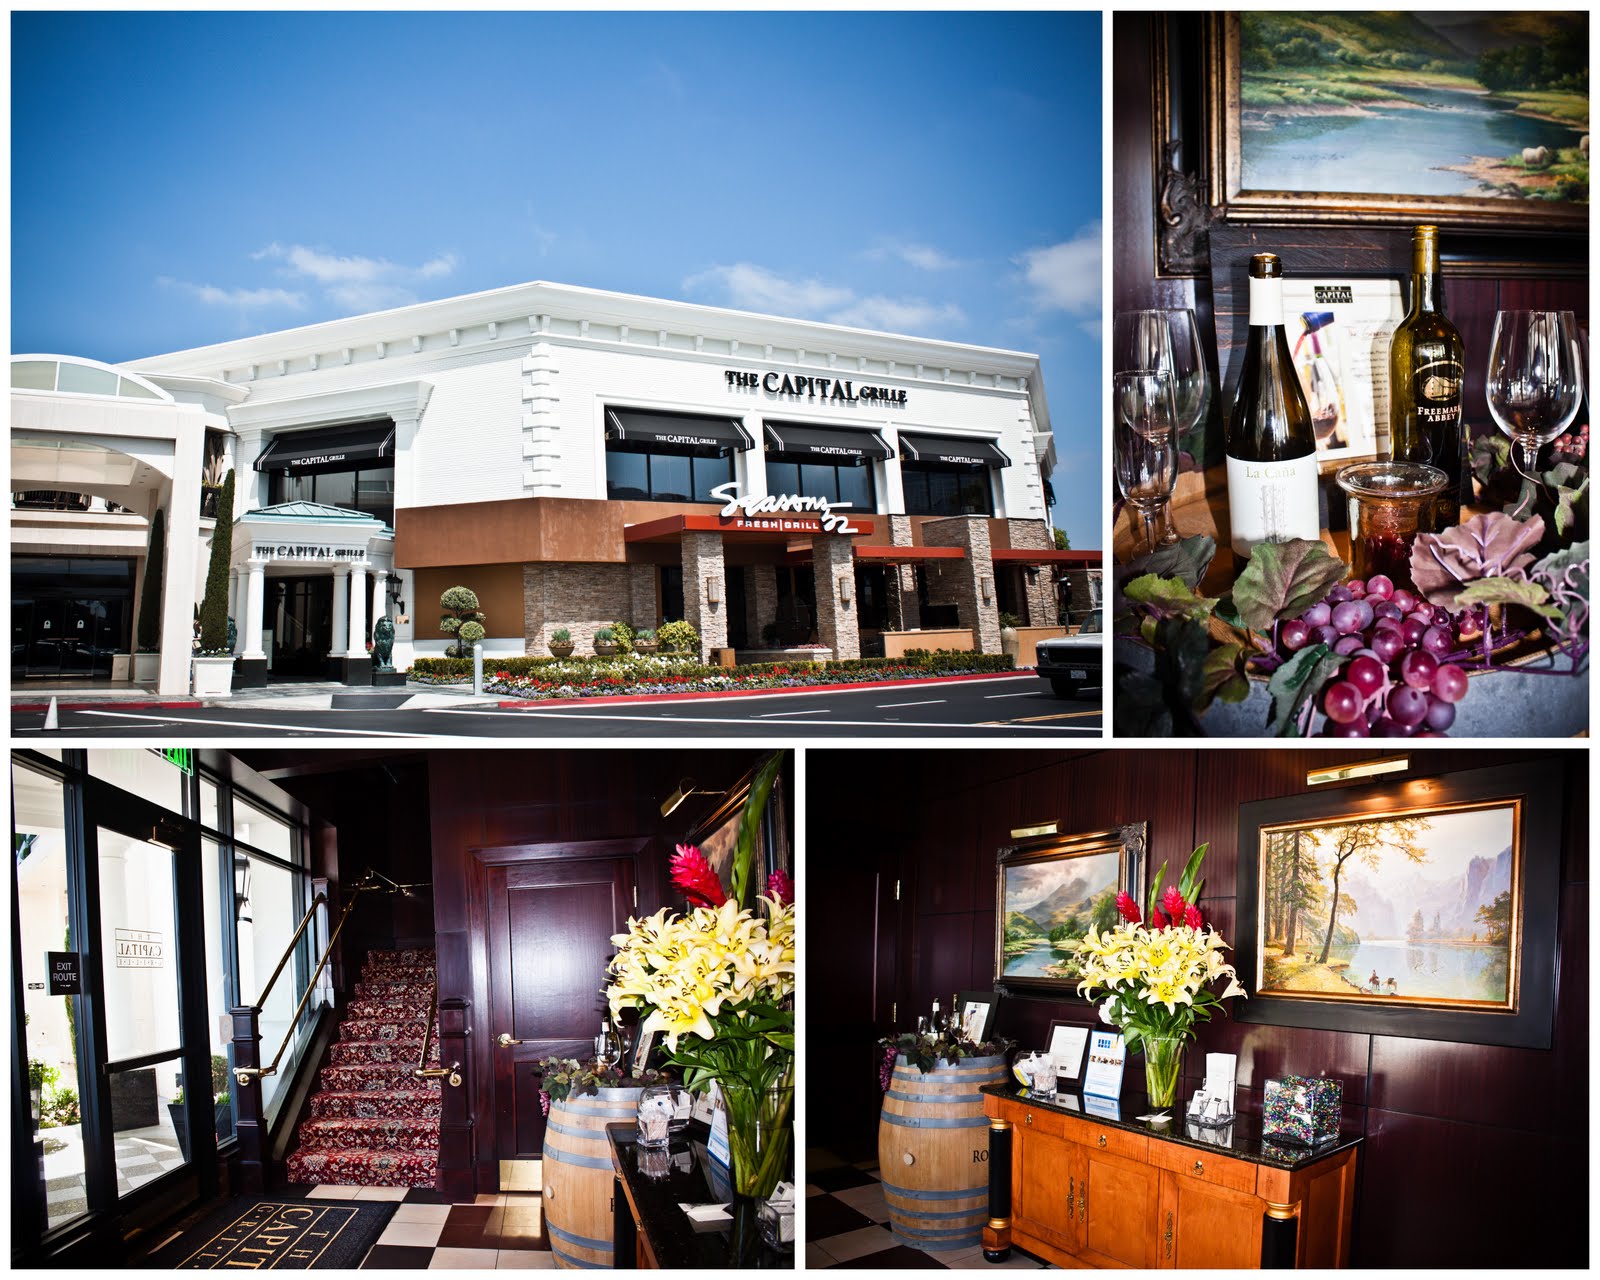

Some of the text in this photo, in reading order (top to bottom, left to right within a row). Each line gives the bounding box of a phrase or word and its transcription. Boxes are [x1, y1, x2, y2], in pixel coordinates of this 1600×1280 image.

[1315, 291, 1352, 299] CAPITAL
[725, 370, 908, 402] THE CAPITAL GRILLE
[1427, 413, 1456, 422] ABBEY
[667, 435, 700, 445] CAPITAL
[820, 446, 848, 455] CAPITAL
[300, 456, 330, 465] CAPITAL
[948, 455, 972, 464] CAPITAL
[1245, 465, 1296, 479] La Caña
[710, 482, 859, 534] Seasons 52
[256, 546, 365, 558] THE CAPITAL GRILLE
[56, 962, 72, 971] EXIT
[53, 973, 77, 981] ROUTE
[973, 1149, 989, 1163] RO
[224, 1207, 314, 1269] CAPIT
